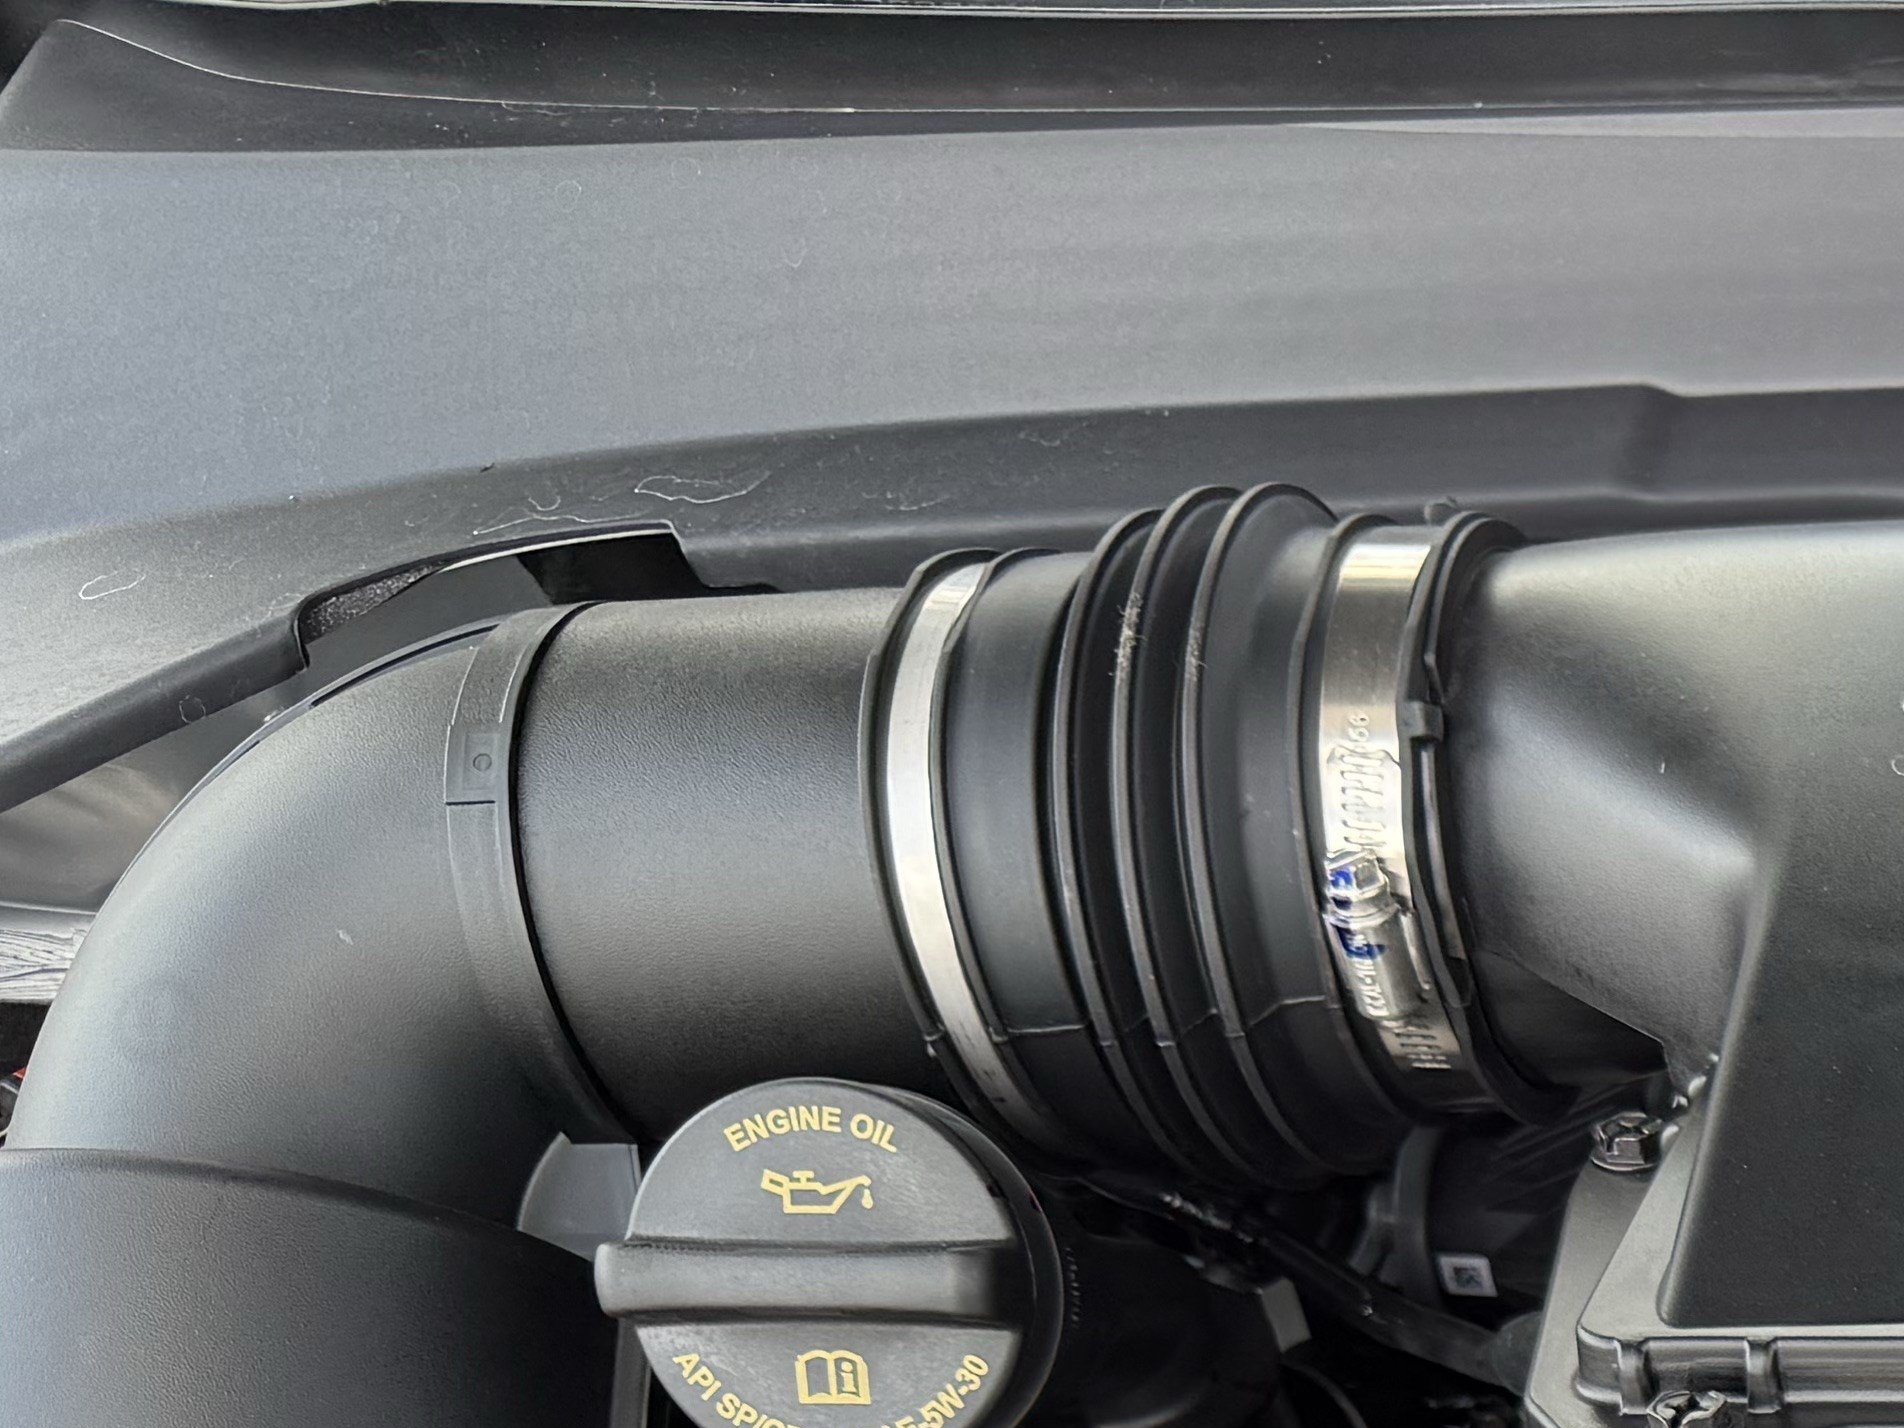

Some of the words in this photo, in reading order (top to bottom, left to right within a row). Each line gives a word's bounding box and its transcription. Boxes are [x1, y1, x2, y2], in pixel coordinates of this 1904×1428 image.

[723, 1105, 843, 1153] ENGINE
[849, 1112, 899, 1153] OIL
[672, 1350, 718, 1402] API
